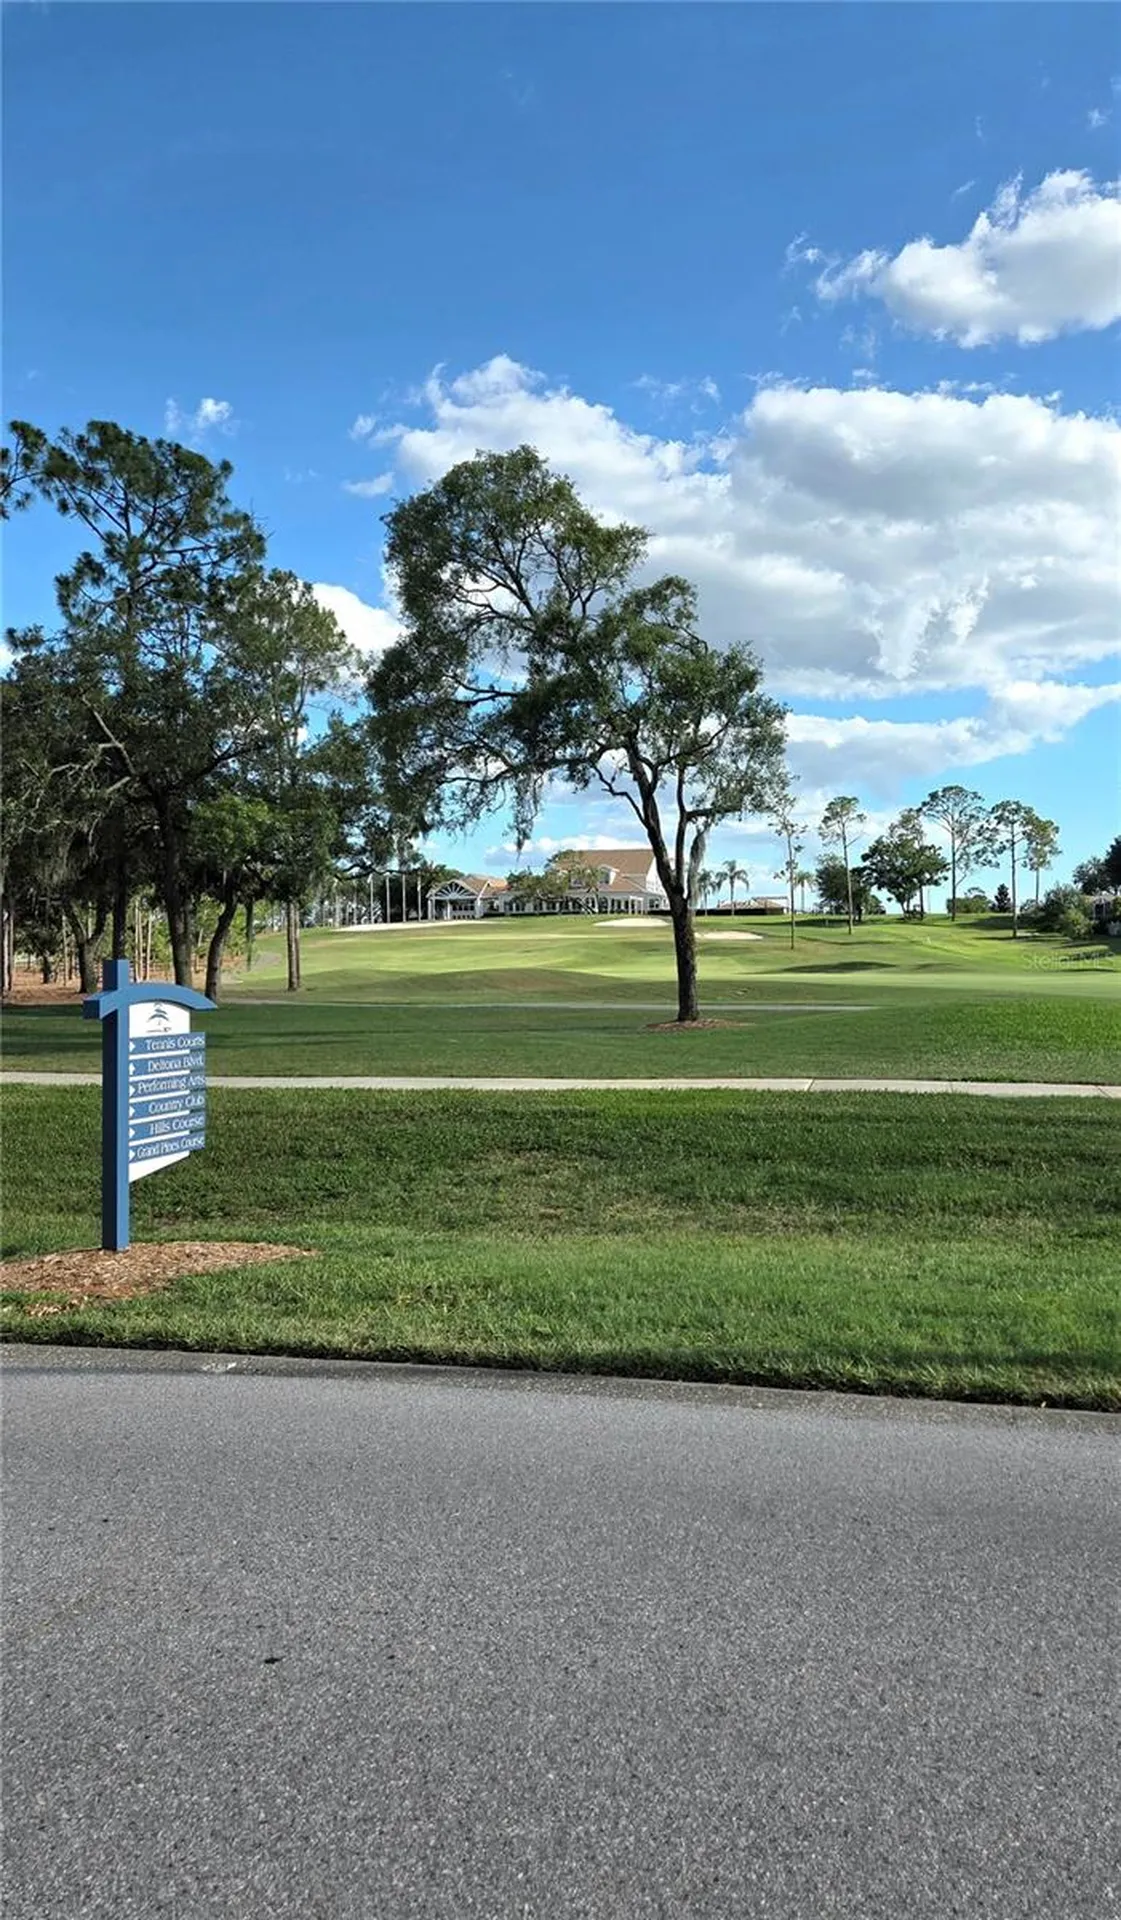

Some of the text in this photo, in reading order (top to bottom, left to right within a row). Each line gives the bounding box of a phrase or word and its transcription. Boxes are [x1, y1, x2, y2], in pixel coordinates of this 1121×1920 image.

[146, 1036, 205, 1050] Tennis Courts
[148, 1058, 181, 1072] Deltona
[138, 1074, 205, 1094] Performing Arts
[149, 1094, 205, 1114] Country Club
[150, 1115, 205, 1135] Hills Course
[137, 1143, 160, 1159] Grand
[181, 1135, 205, 1150] Course
